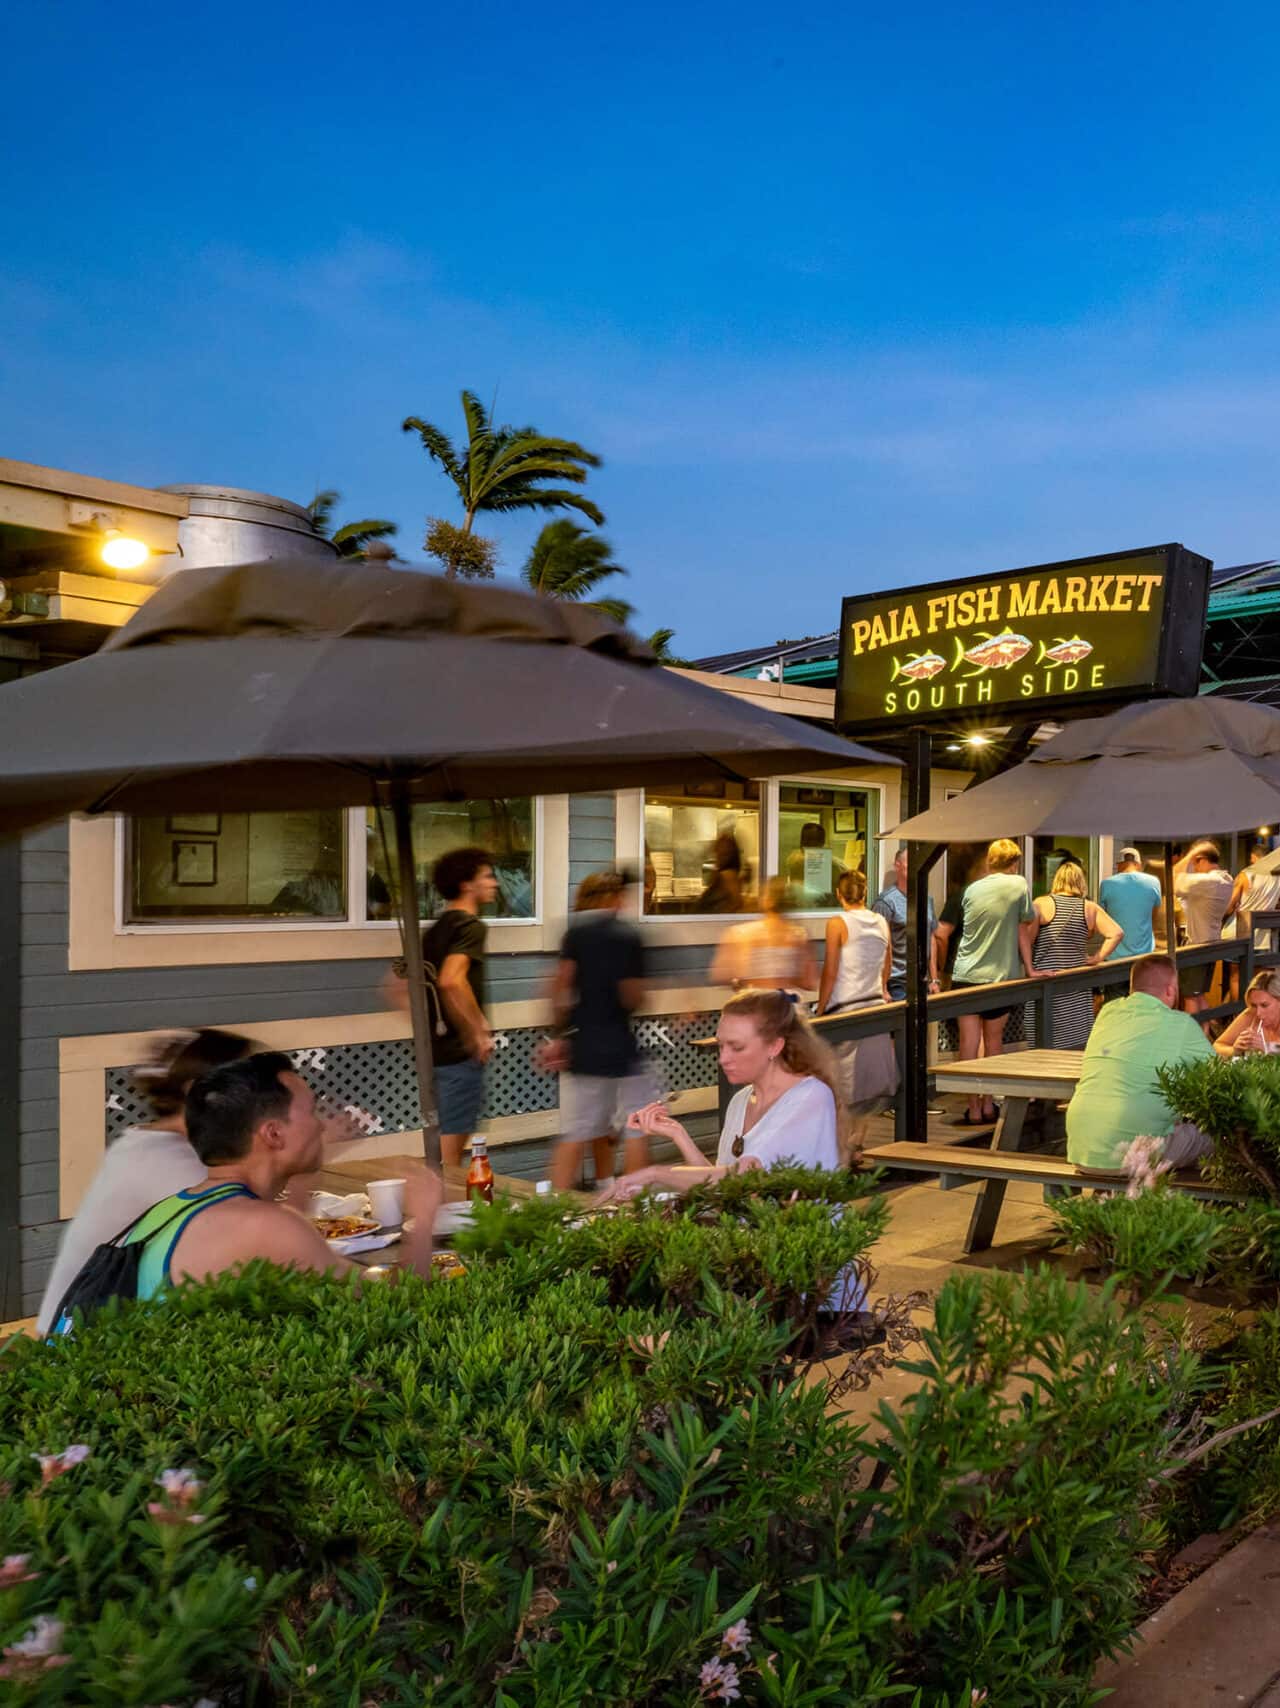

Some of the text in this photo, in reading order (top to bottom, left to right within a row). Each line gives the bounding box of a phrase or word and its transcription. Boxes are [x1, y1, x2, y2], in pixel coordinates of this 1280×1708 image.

[852, 575, 1163, 656] PAIA FISH MARKET
[885, 665, 1105, 714] SOUTH SIDE
